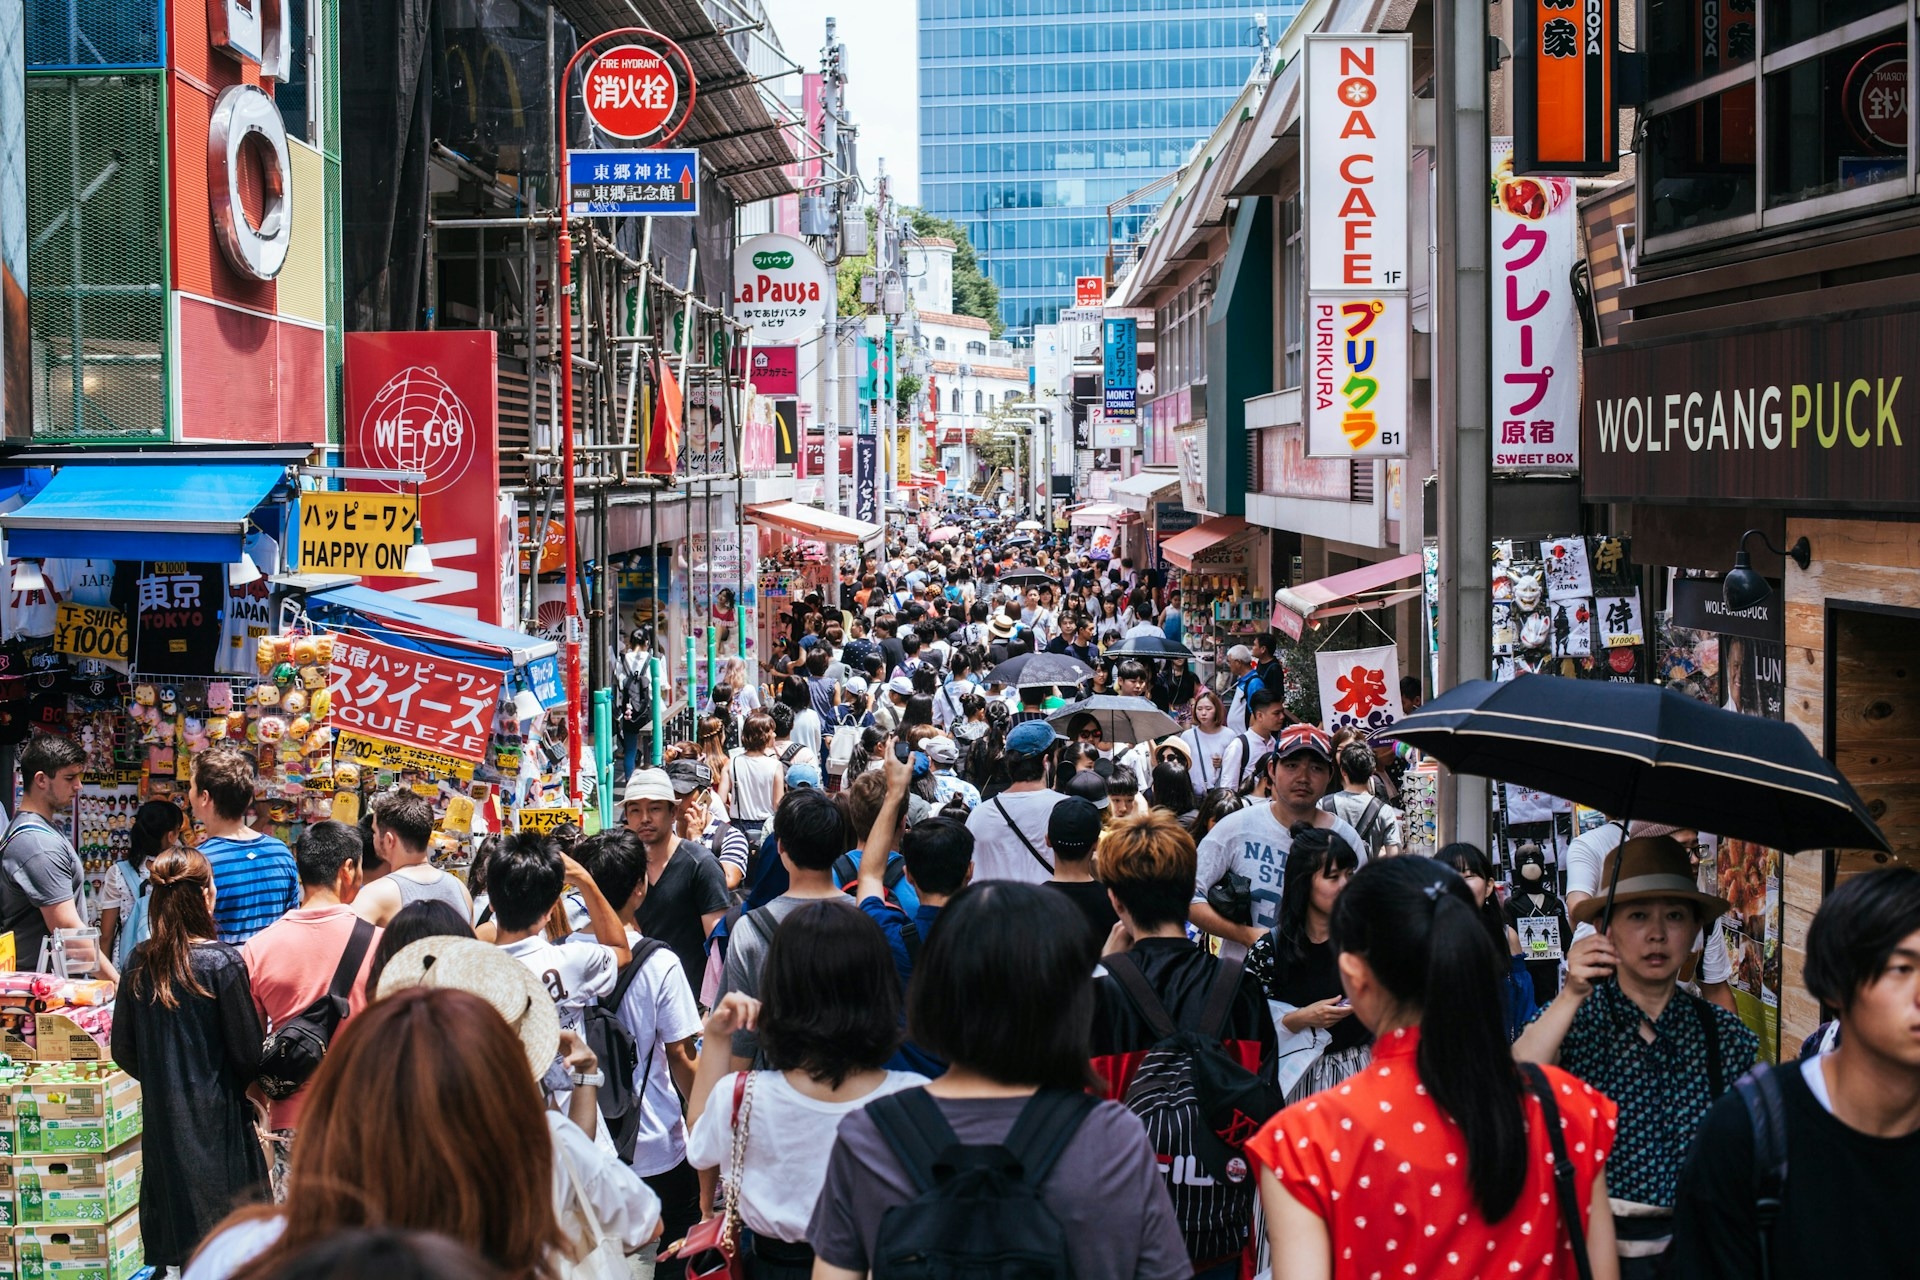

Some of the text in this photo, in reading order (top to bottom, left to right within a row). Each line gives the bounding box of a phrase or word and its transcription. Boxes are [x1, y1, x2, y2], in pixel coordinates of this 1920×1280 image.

[600, 58, 660, 68] FIRE HYDRANT
[594, 74, 668, 109] 消火栓
[594, 164, 672, 180] 東郷神社
[1337, 47, 1377, 284] NOA CAFE
[592, 184, 676, 202] 東郷記念館
[757, 275, 820, 304] Pausa
[1384, 272, 1402, 284] 1F
[1502, 223, 1554, 416] クレープ
[756, 358, 766, 366] 6F
[1116, 323, 1126, 386] コインロッカー
[1316, 305, 1334, 411] PURIKURA
[1340, 300, 1384, 450] プリクラ
[1106, 390, 1135, 400] MONEY
[1596, 376, 1902, 453] WOLFGANG PUCK
[1382, 432, 1400, 445] B1
[1501, 420, 1555, 444] 原宿
[1496, 453, 1574, 465] SWEET BOX
[304, 502, 417, 533] ハッピーワン
[303, 541, 368, 568] HAPPY
[1198, 554, 1230, 564] SOCKS
[136, 572, 203, 612] 東京
[140, 612, 203, 630] TOKYO
[231, 600, 270, 623] JAPAN
[1605, 598, 1633, 634] 侍
[1610, 637, 1636, 645] ¥1000
[332, 642, 498, 696] 原宿ハッピーワン
[1608, 676, 1636, 684] JAPAN
[330, 664, 494, 736] スクイーズ
